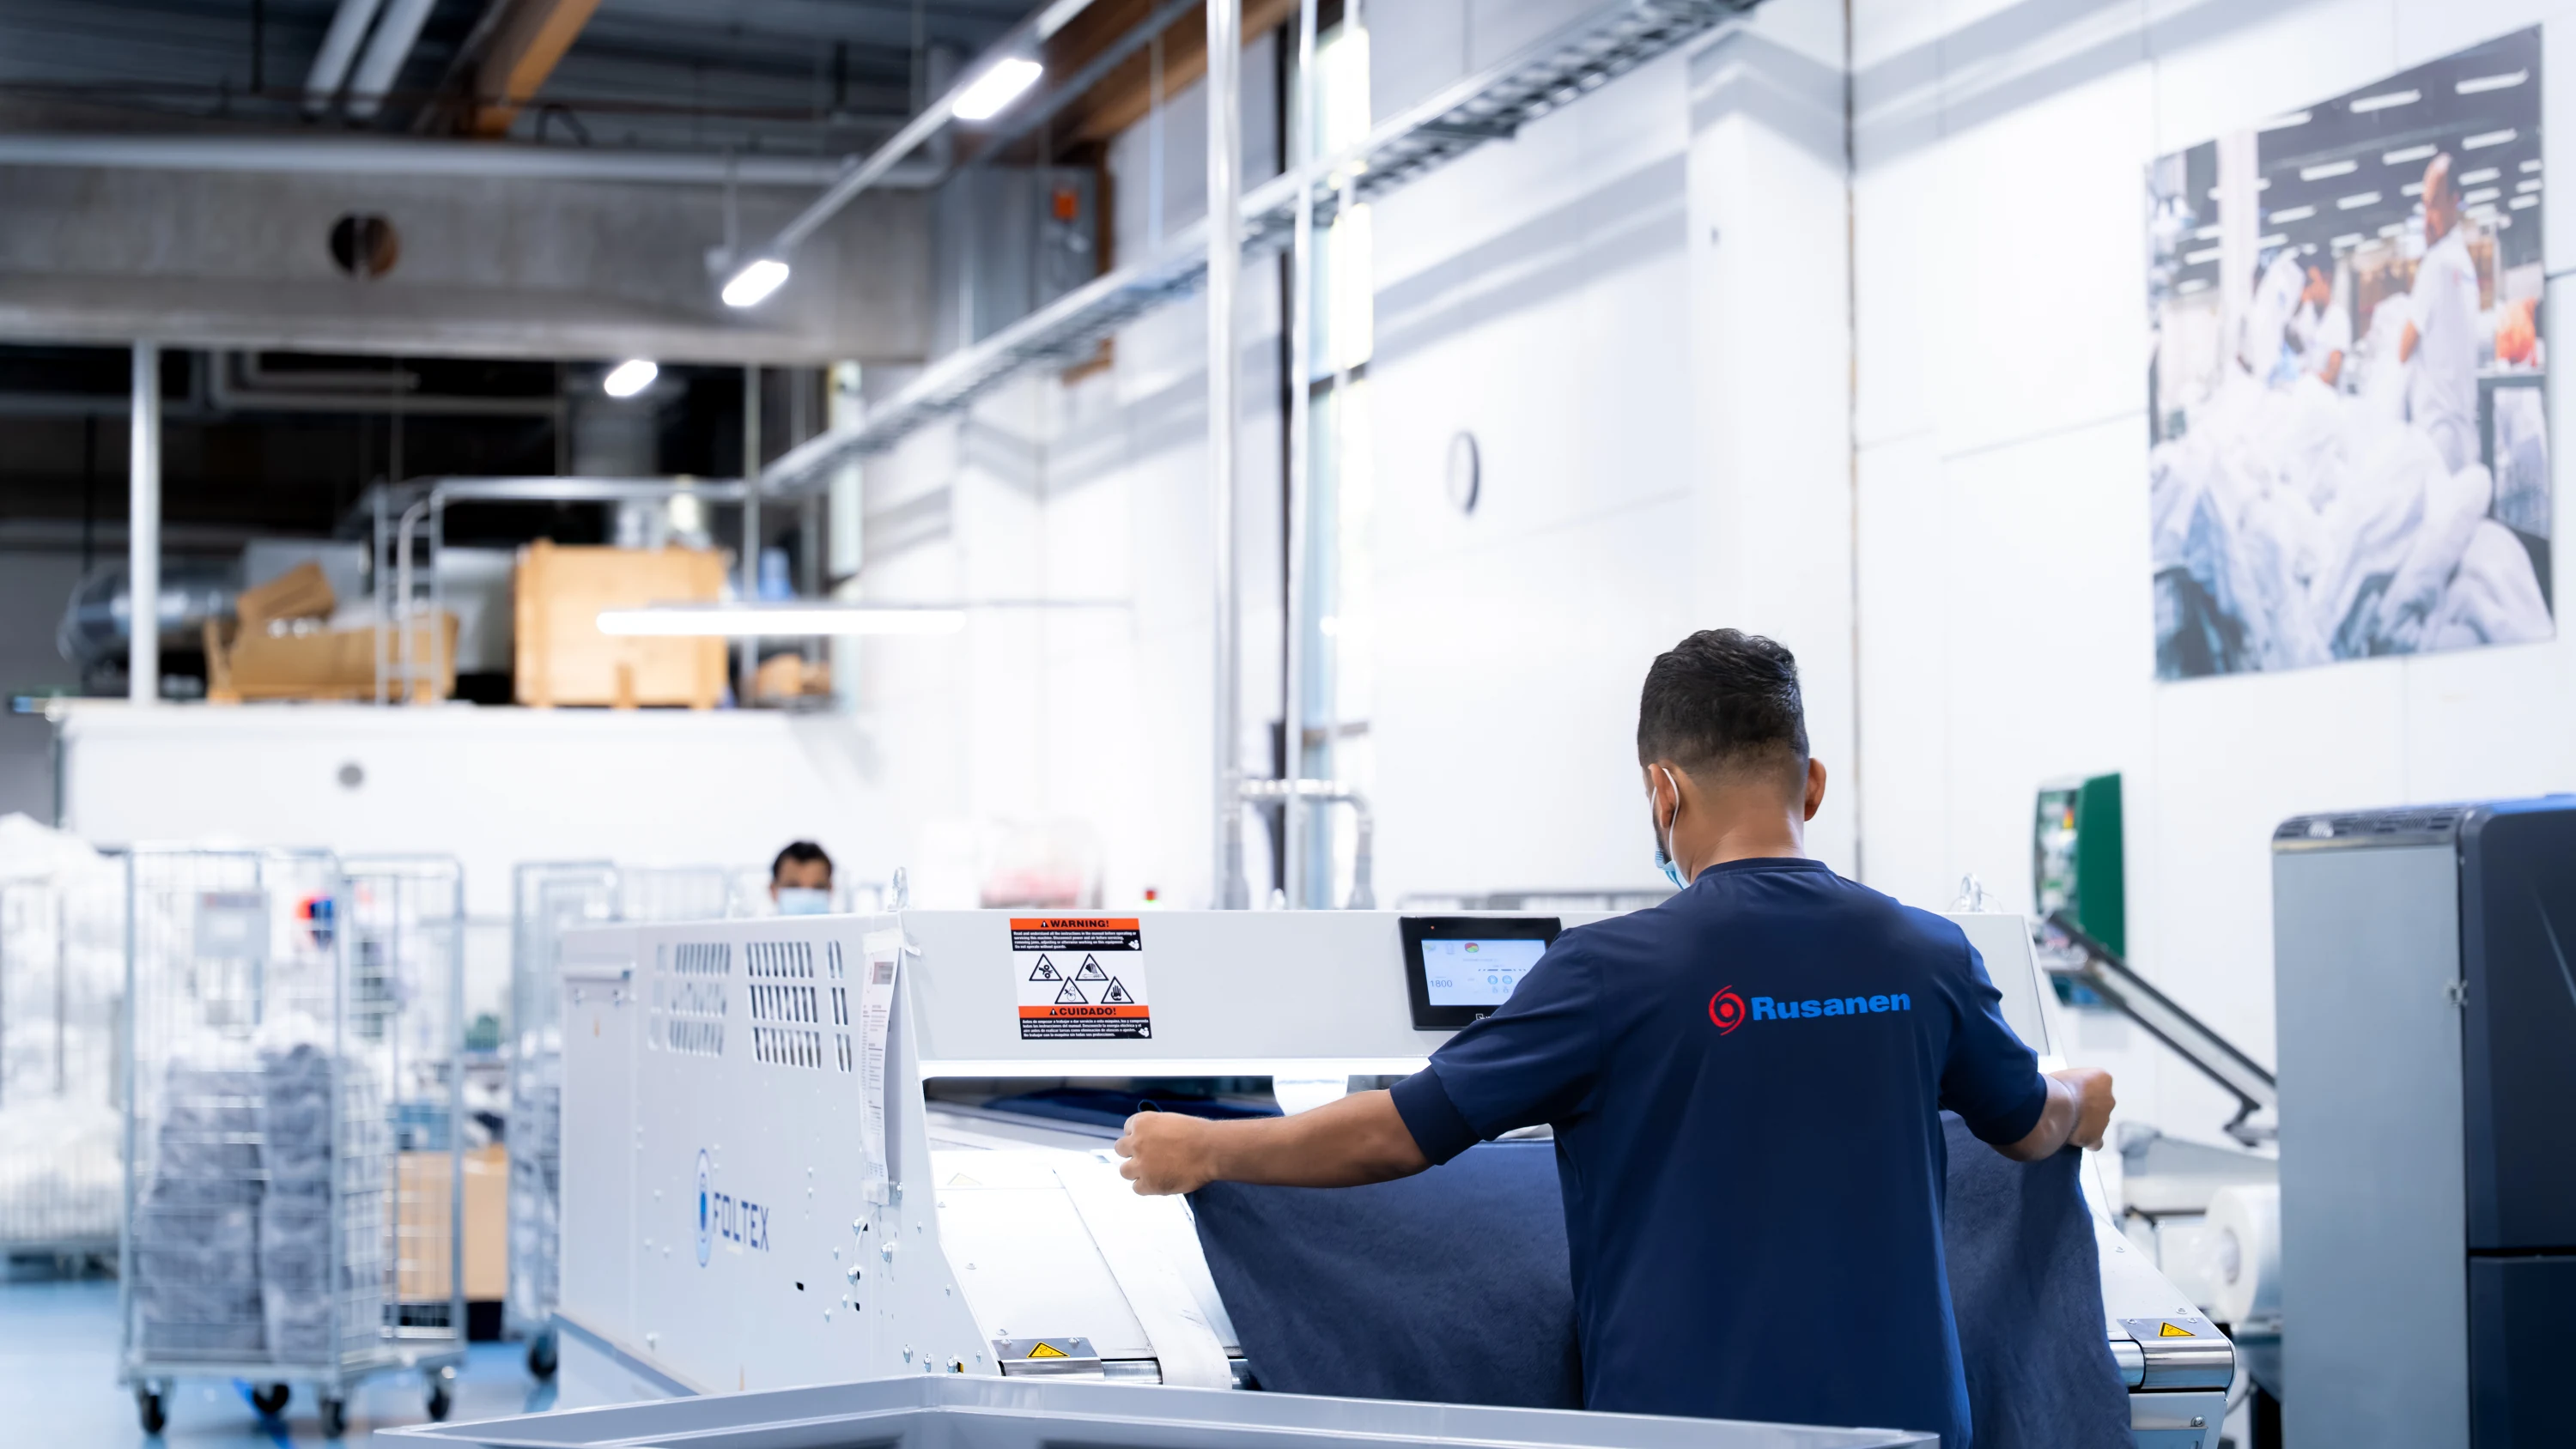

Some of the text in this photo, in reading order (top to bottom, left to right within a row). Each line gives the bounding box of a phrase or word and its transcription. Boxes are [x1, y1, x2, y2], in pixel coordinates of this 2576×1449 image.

[1050, 919, 1109, 928] WARNING!
[1431, 979, 1453, 988] 1800
[1751, 992, 1911, 1021] Rusanen
[1059, 1007, 1116, 1016] CUIDADO!
[714, 1191, 769, 1252] FOLTEX
